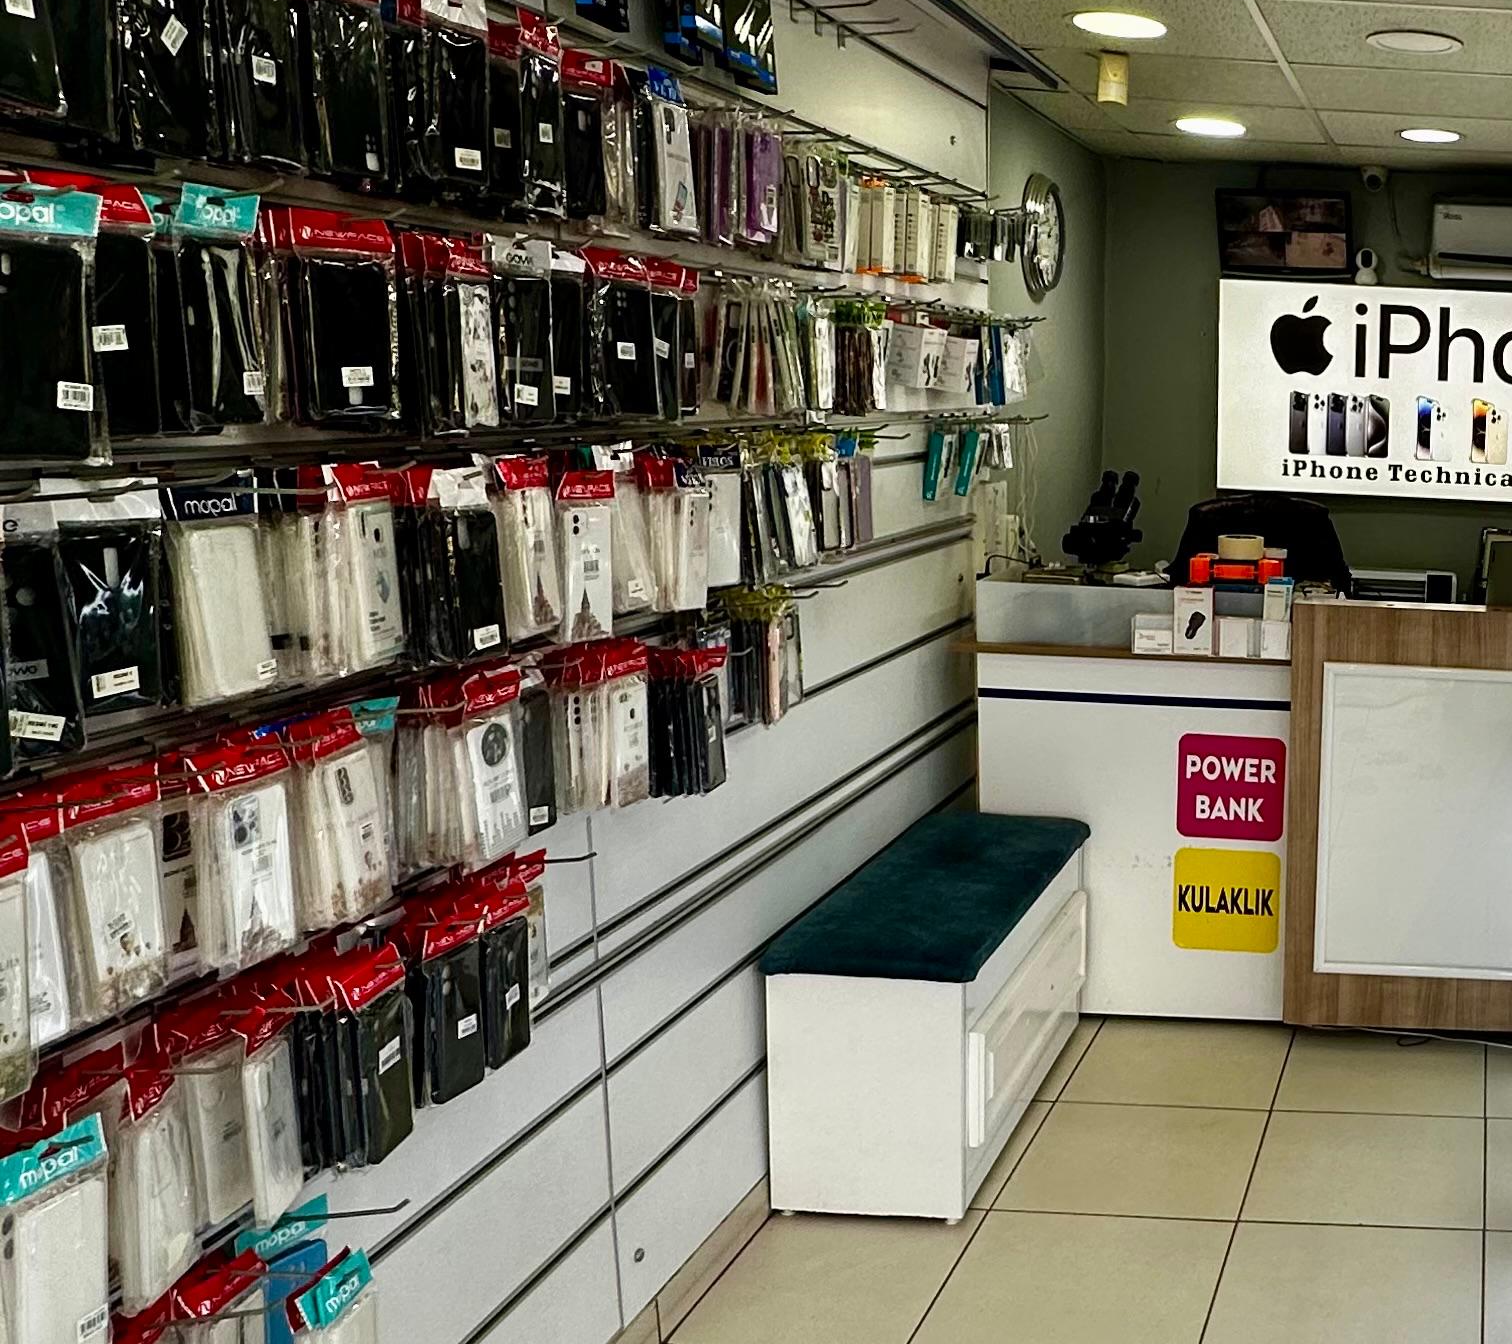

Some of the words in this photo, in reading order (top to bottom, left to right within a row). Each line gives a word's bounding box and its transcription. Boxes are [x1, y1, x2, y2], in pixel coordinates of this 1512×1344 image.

[0, 202, 55, 224] opal
[313, 229, 385, 244] NEWFACE
[1281, 459, 1378, 482] iPhone
[184, 492, 238, 517] mopal
[1185, 754, 1277, 784] POWER
[1195, 794, 1265, 823] BANK
[1178, 884, 1274, 916] KULAKLIK
